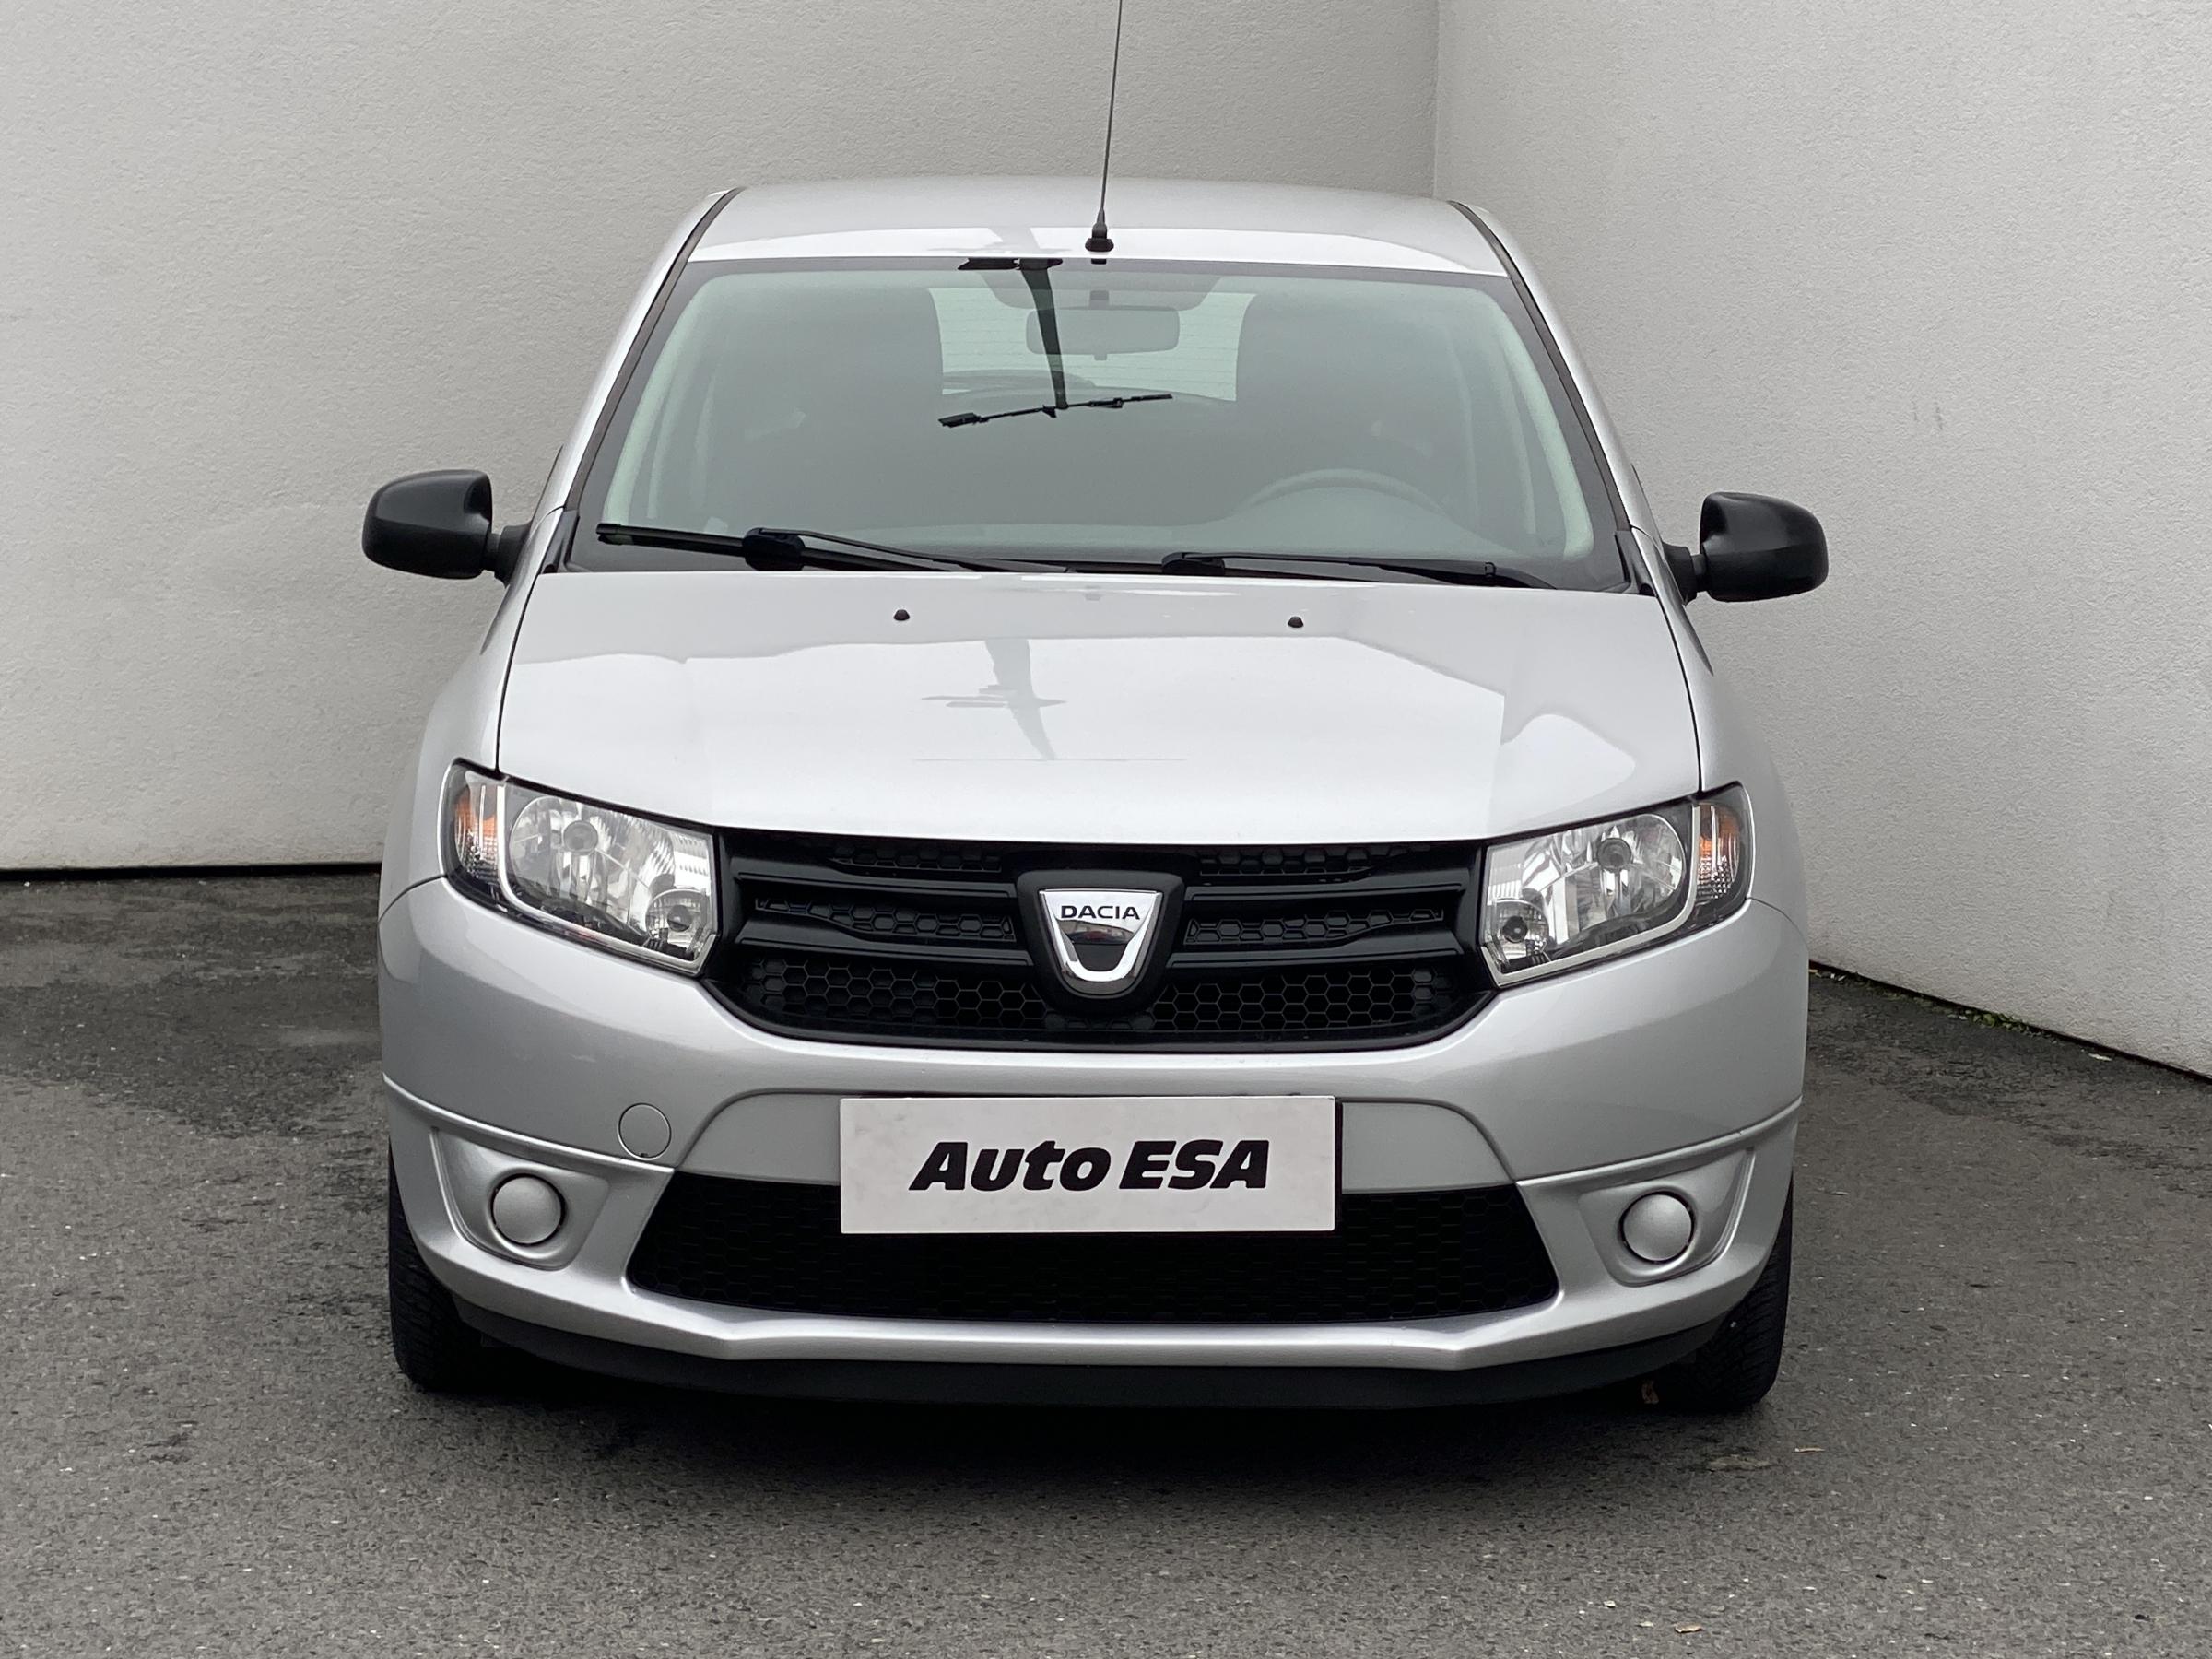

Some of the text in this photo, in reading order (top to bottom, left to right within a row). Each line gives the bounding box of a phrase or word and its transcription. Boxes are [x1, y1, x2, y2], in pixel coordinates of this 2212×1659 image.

[1061, 905, 1140, 920] DACIA
[908, 1139, 1270, 1192] Auto ESA
